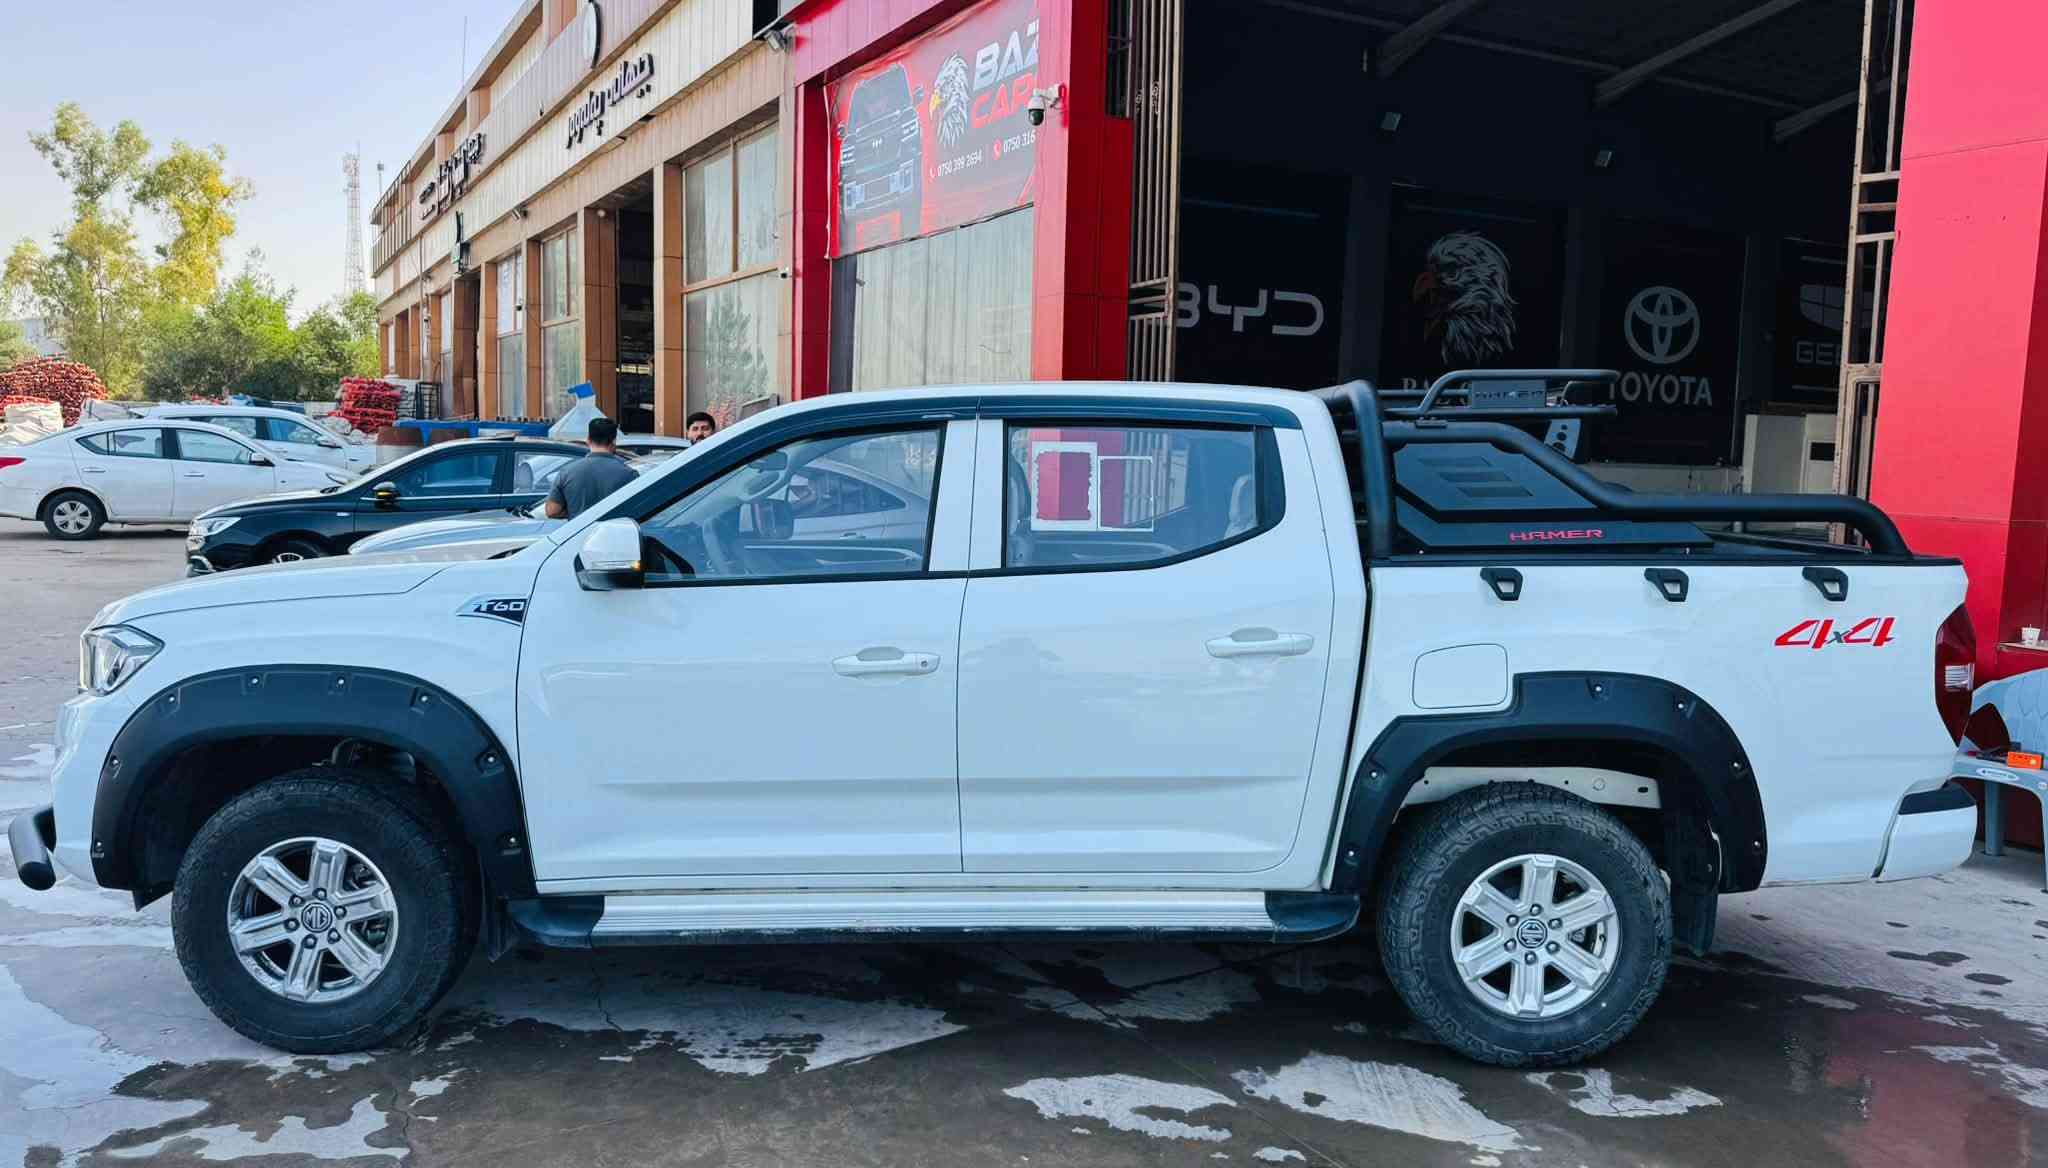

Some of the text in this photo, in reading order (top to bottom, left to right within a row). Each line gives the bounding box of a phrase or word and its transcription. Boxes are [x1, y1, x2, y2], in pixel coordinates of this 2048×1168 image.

[1176, 281, 1324, 336] BYD
[1509, 528, 1603, 541] HAMER
[472, 601, 525, 612] T60
[303, 907, 328, 929] MG
